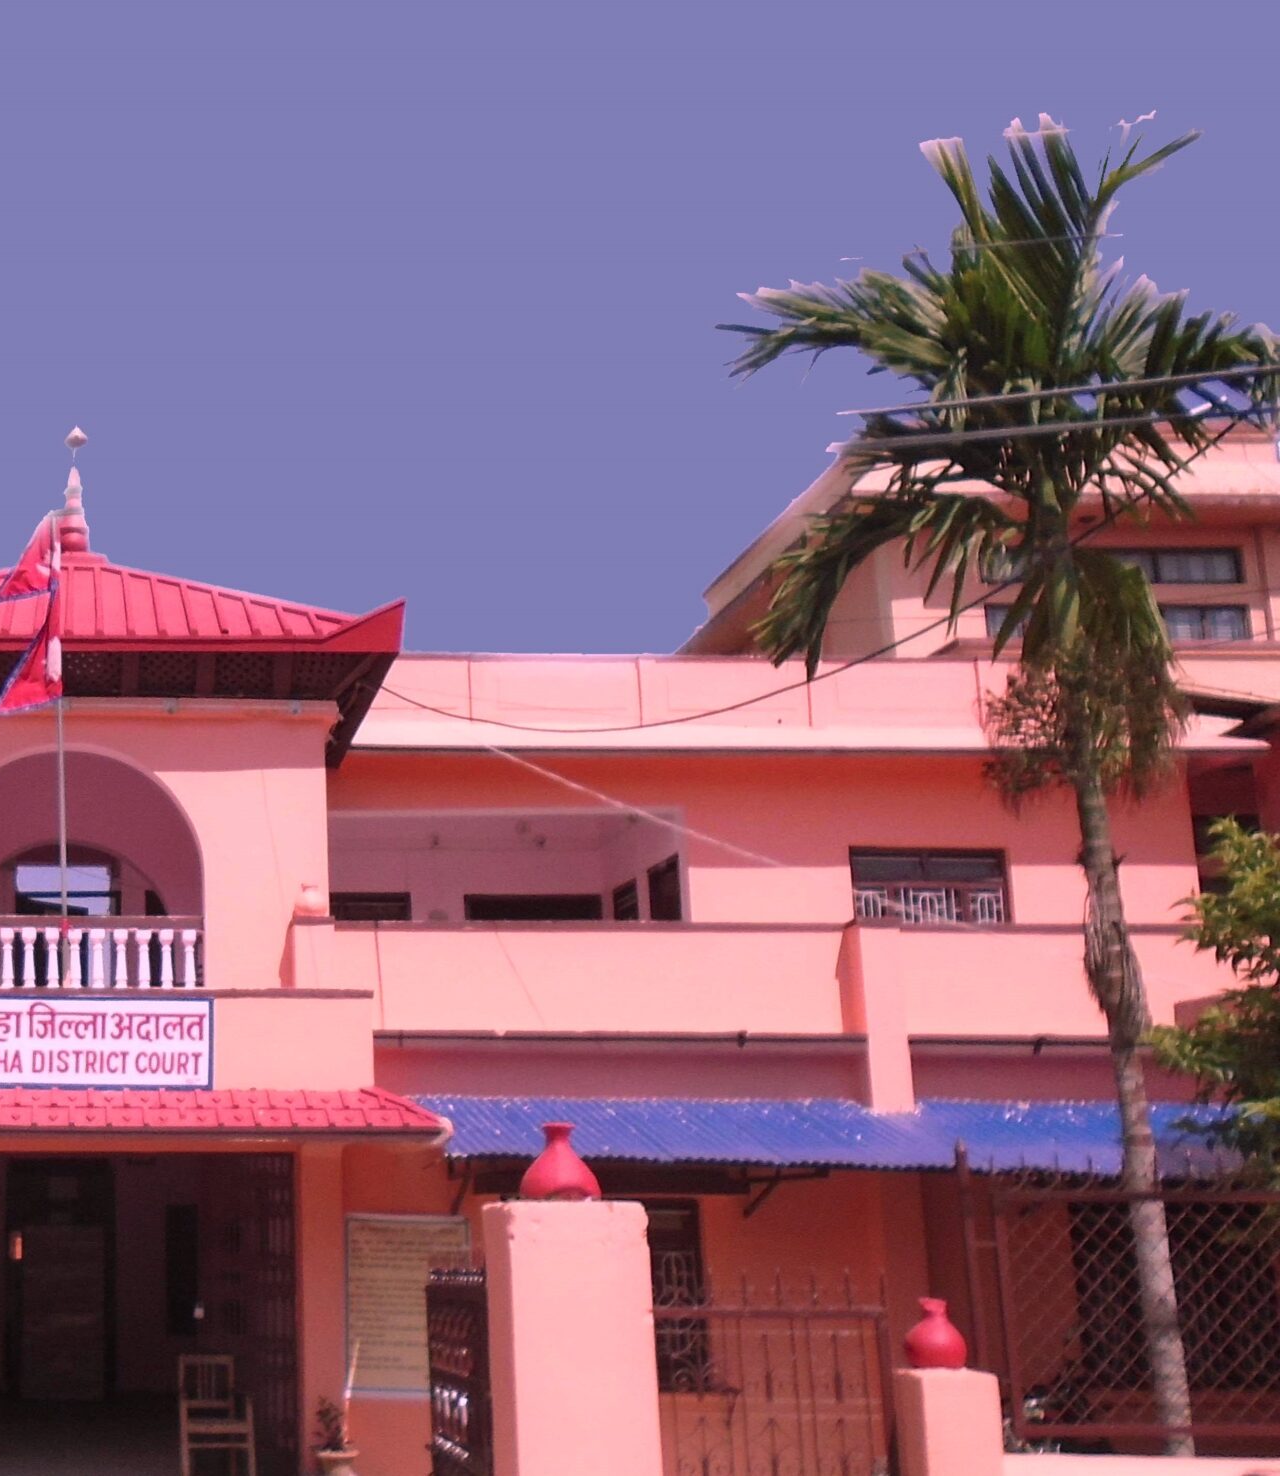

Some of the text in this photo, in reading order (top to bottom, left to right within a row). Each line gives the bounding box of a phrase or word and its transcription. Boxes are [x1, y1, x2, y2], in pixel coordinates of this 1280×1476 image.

[27, 1002, 107, 1040] जिल्ला
[110, 1012, 206, 1042] अदालत
[31, 1050, 129, 1074] DISTRICT
[135, 1051, 202, 1076] COURT
